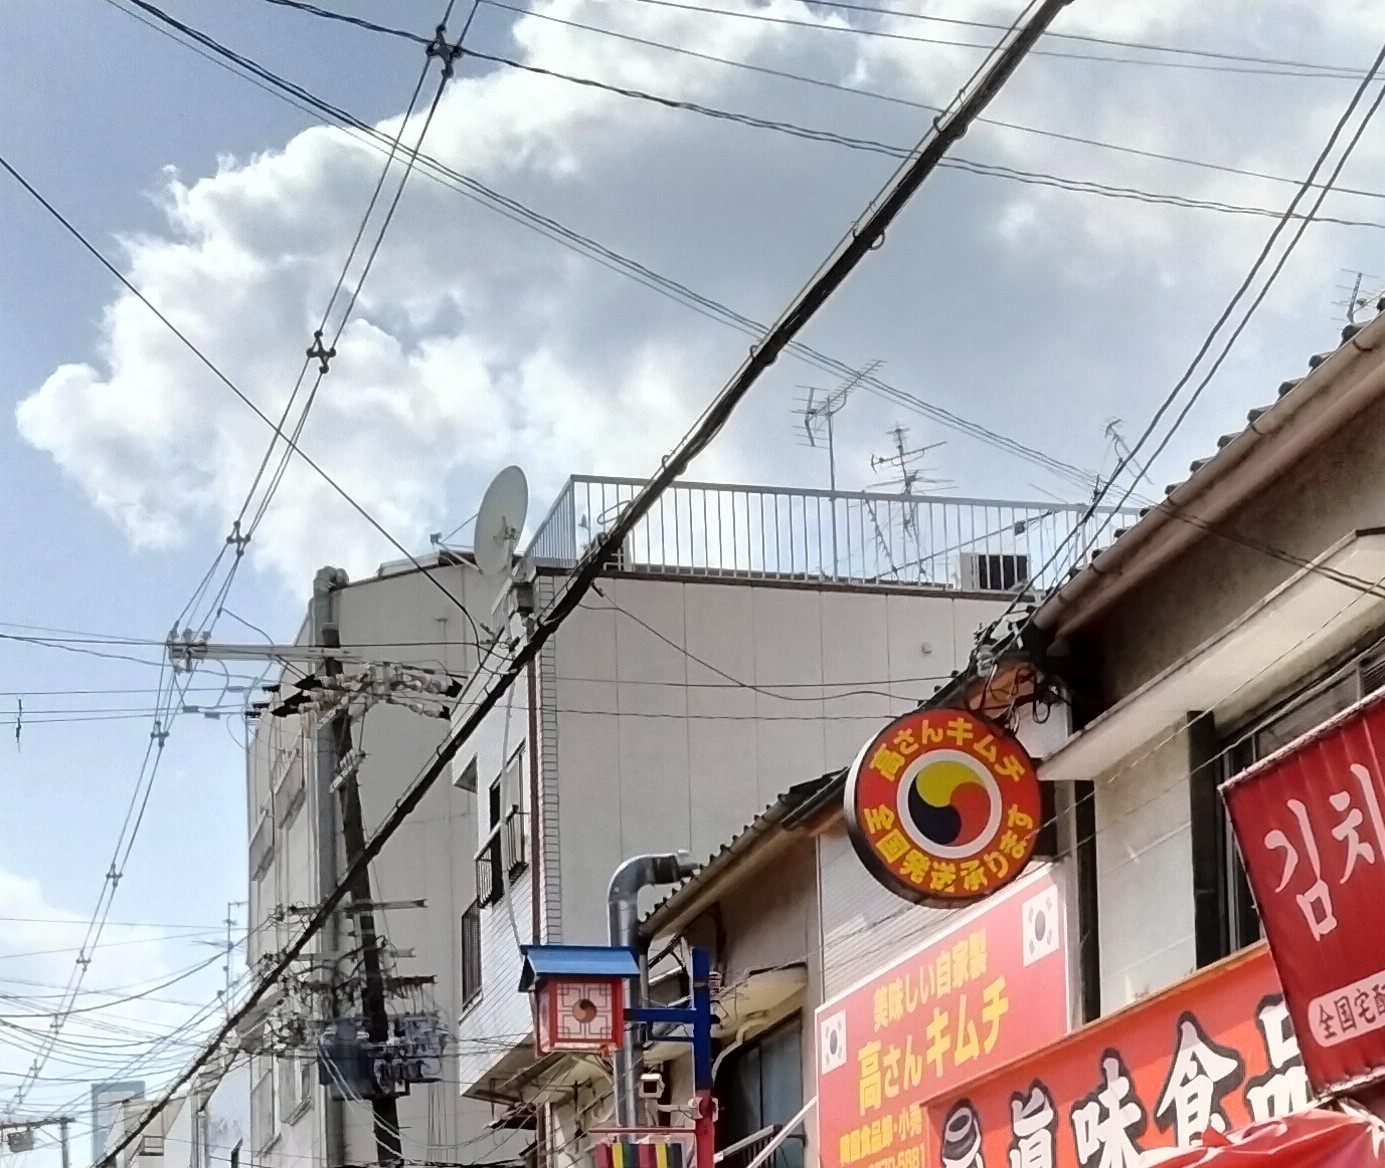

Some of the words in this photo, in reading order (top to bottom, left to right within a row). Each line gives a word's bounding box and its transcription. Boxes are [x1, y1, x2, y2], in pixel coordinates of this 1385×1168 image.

[870, 717, 1025, 783] 高さんキムチ
[873, 928, 988, 1034] 美味しい自家製
[858, 975, 1010, 1116] 高さんキムチ
